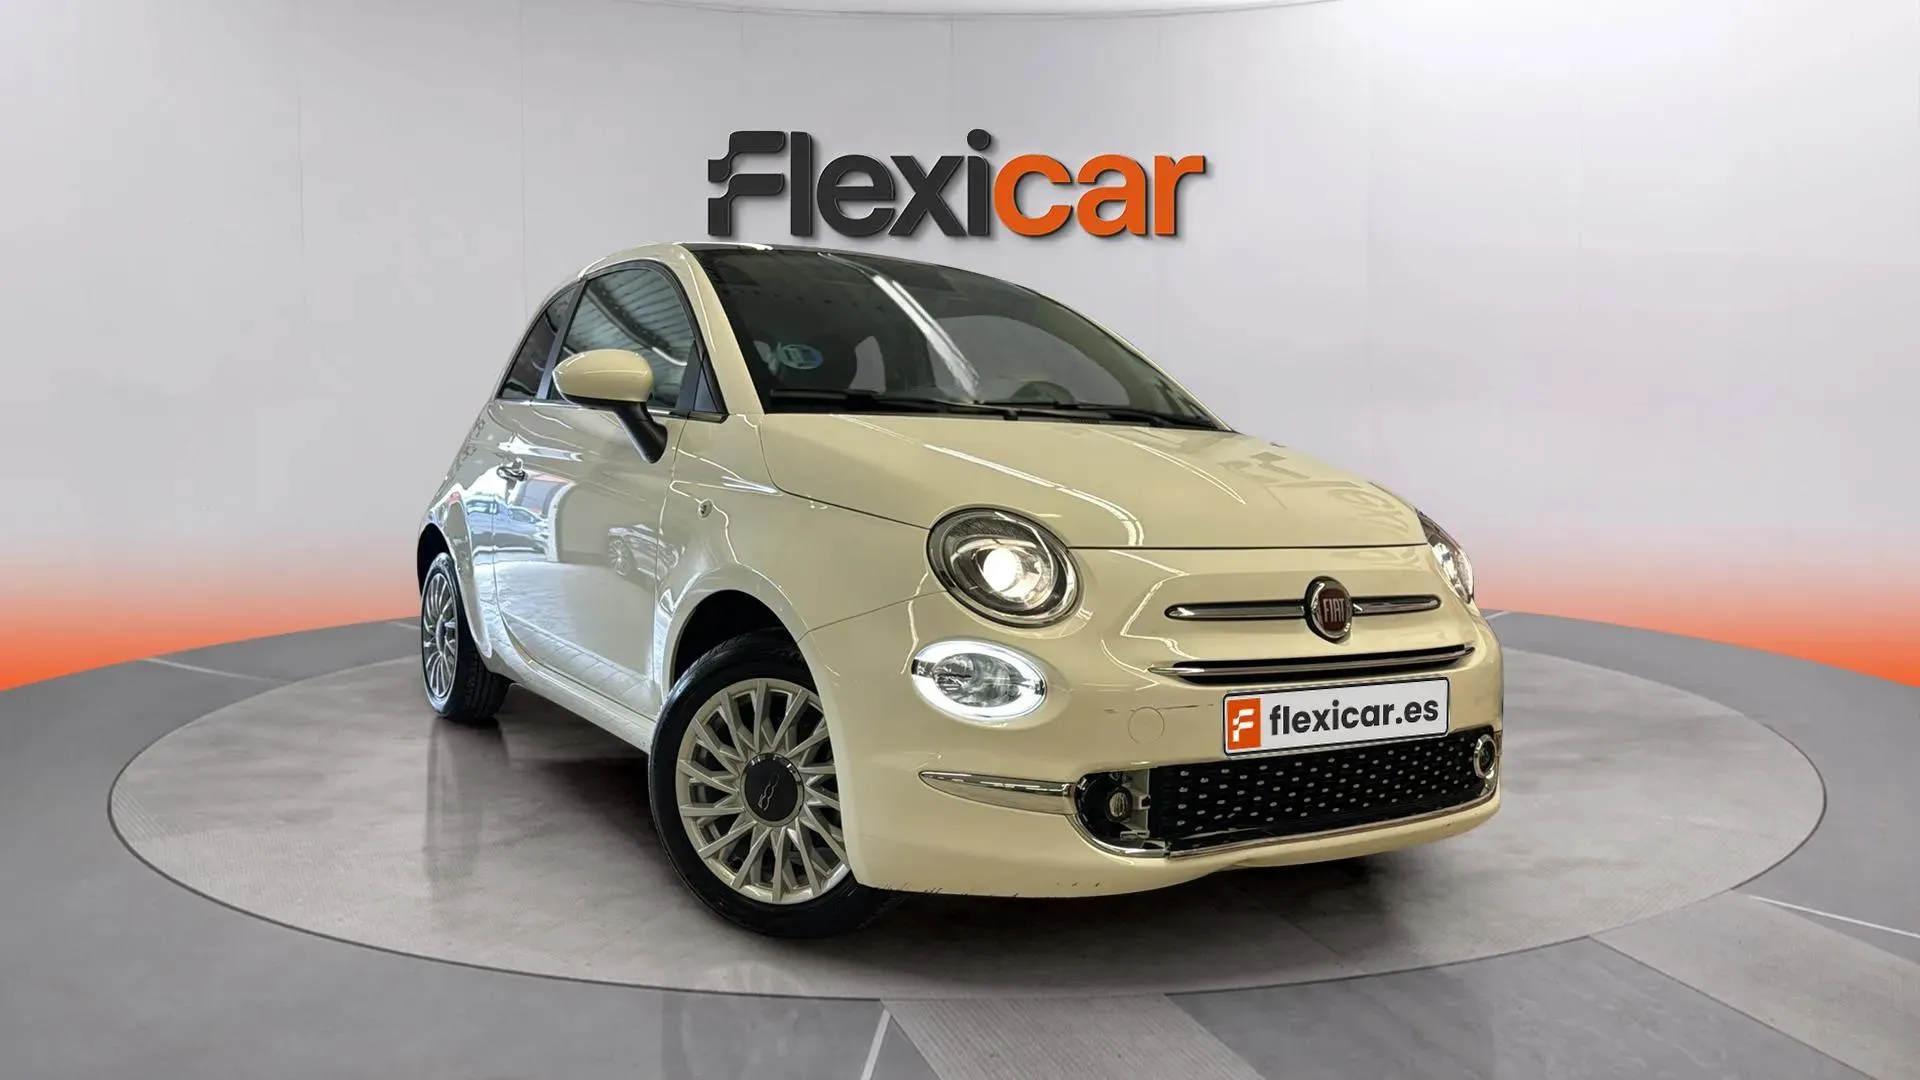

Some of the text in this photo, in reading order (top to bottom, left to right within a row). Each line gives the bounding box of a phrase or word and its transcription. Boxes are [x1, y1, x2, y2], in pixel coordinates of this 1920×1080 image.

[707, 128, 1207, 237] Flexicar
[1322, 597, 1345, 623] FIAT
[1269, 699, 1439, 736] flexicar.es
